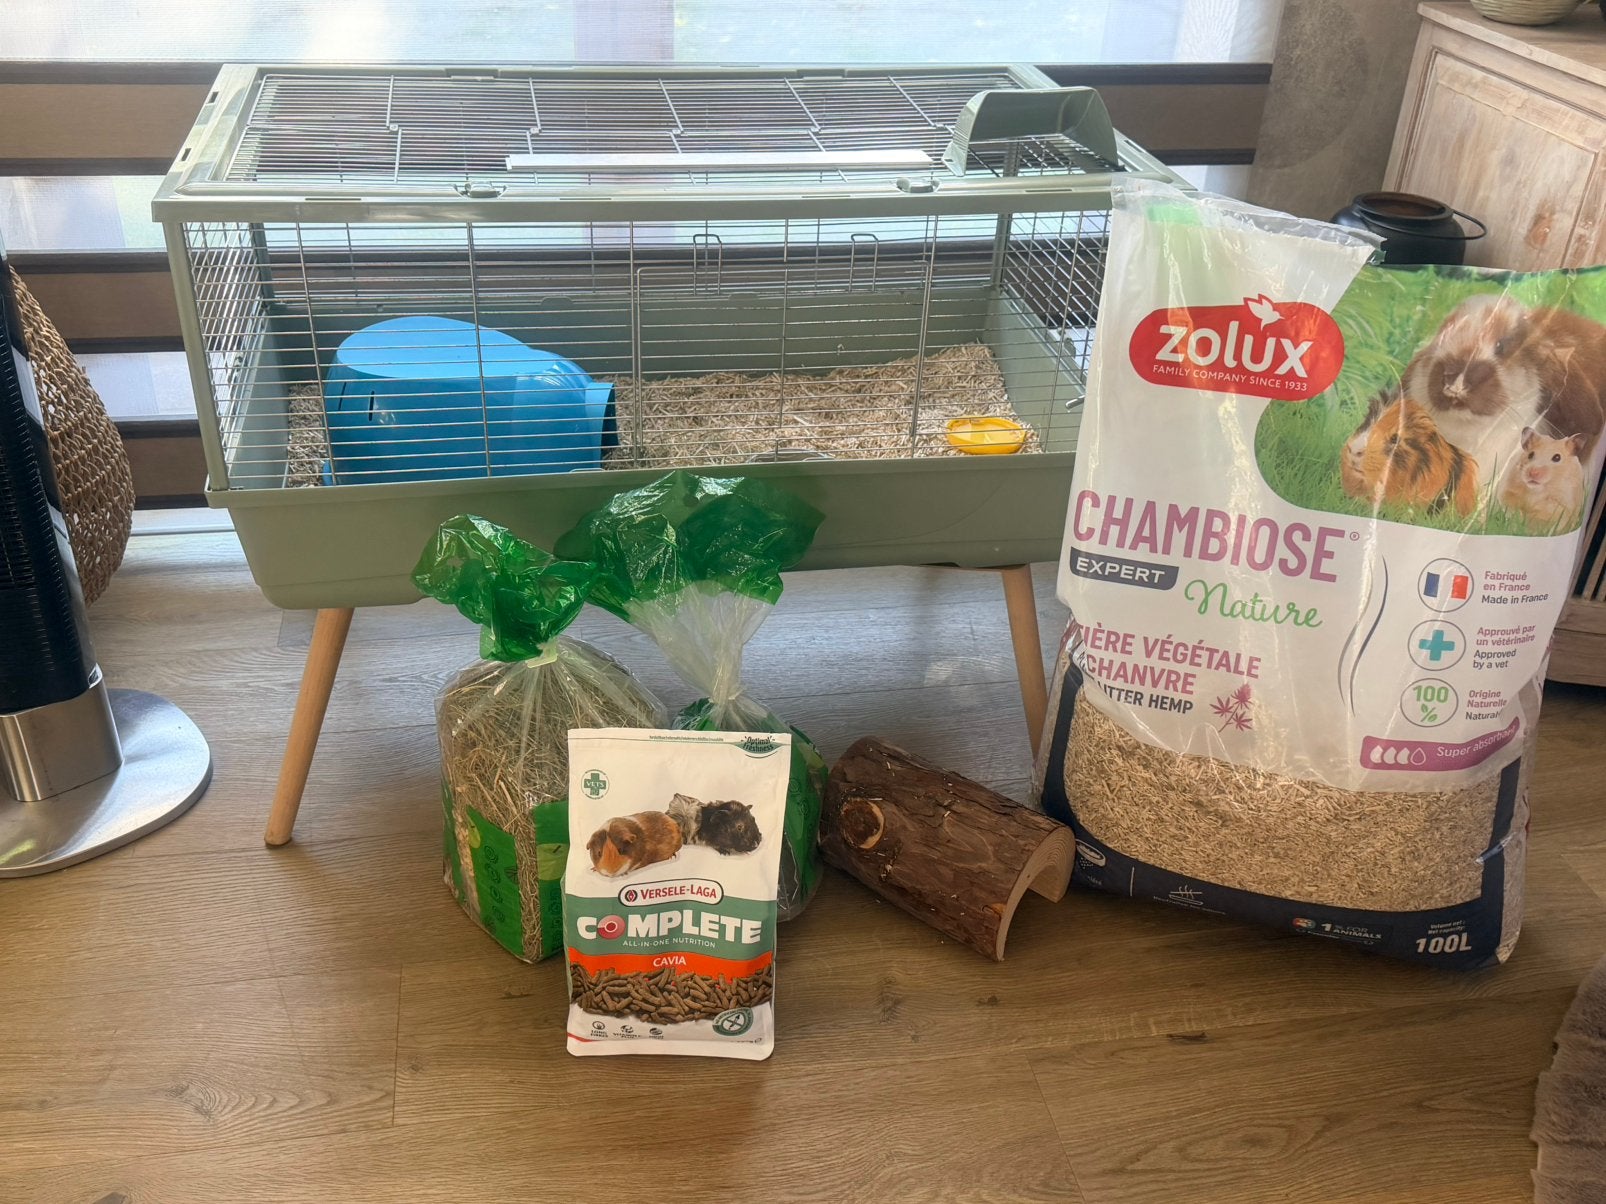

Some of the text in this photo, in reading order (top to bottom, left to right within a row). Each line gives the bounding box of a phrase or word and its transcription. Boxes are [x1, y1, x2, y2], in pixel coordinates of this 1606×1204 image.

[1152, 364, 1308, 392] FAMILY COMPANY SINCE 1933
[1076, 557, 1166, 583] EXPERT
[1484, 570, 1528, 582] Fabriqué
[1483, 582, 1531, 592] en France
[1184, 579, 1323, 628] Nature
[1481, 593, 1549, 604] Made in France
[1477, 625, 1536, 637] Approuvé par
[1476, 638, 1488, 646] un
[1142, 633, 1262, 680] VÉGÉTALE
[1474, 649, 1517, 660] Approved
[1473, 660, 1484, 671] by
[1495, 660, 1509, 669] vet
[1086, 653, 1197, 695] CHANVRE
[1413, 685, 1449, 704] 100
[1468, 689, 1502, 700] Origine
[1147, 693, 1194, 715] HEMP
[1436, 745, 1472, 758] Super
[640, 884, 717, 900] VERSELE-LAGA
[576, 909, 762, 945] COMPLETE
[1333, 929, 1383, 939] ANIMALS
[622, 937, 716, 948] ALL-IN-ONE NUTRITION
[1415, 932, 1473, 954] 100L
[652, 956, 687, 968] CAVIA
